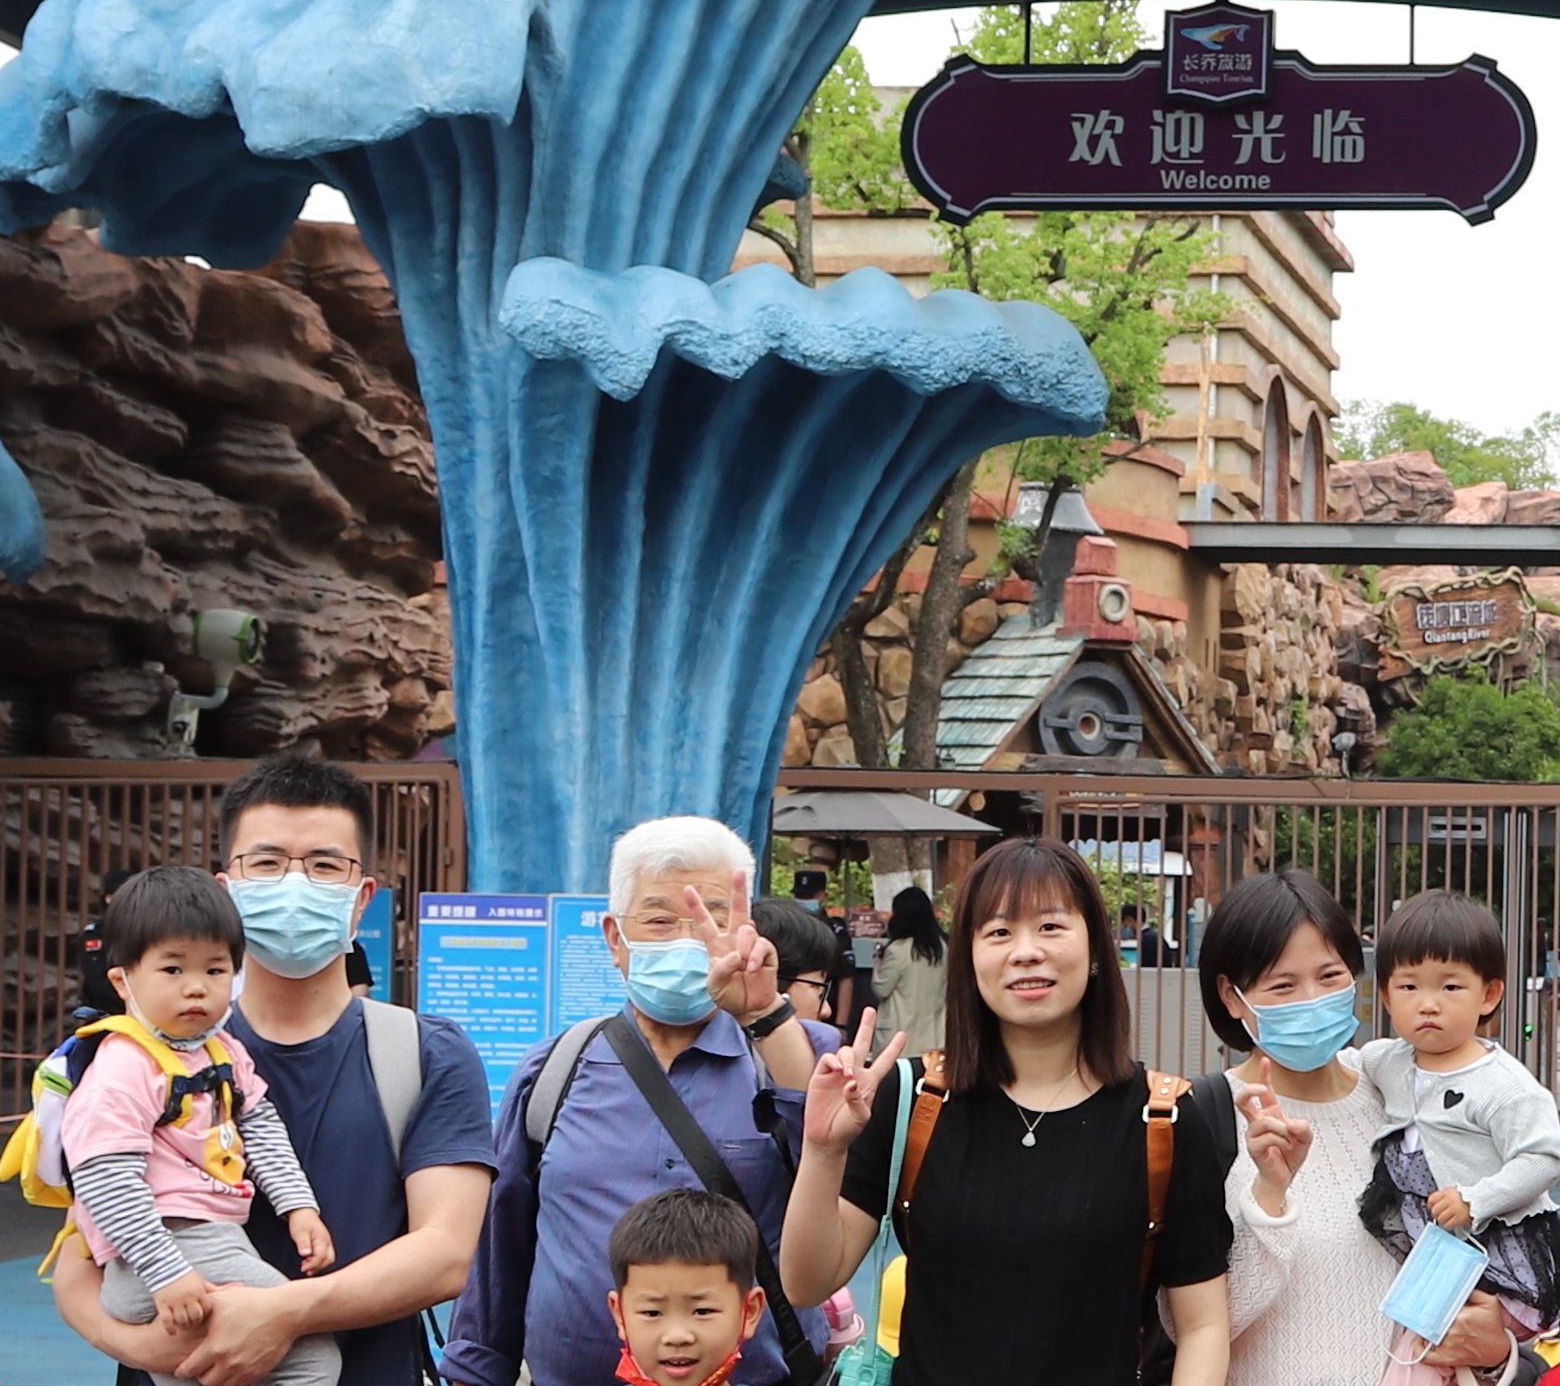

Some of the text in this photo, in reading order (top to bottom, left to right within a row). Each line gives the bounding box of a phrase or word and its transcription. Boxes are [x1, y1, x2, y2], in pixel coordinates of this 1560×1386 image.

[1183, 53, 1253, 71] 长乔旅游
[1069, 108, 1365, 166] 欢迎光临
[1160, 170, 1271, 191] Welcome
[1424, 630, 1468, 644] Qiantang
